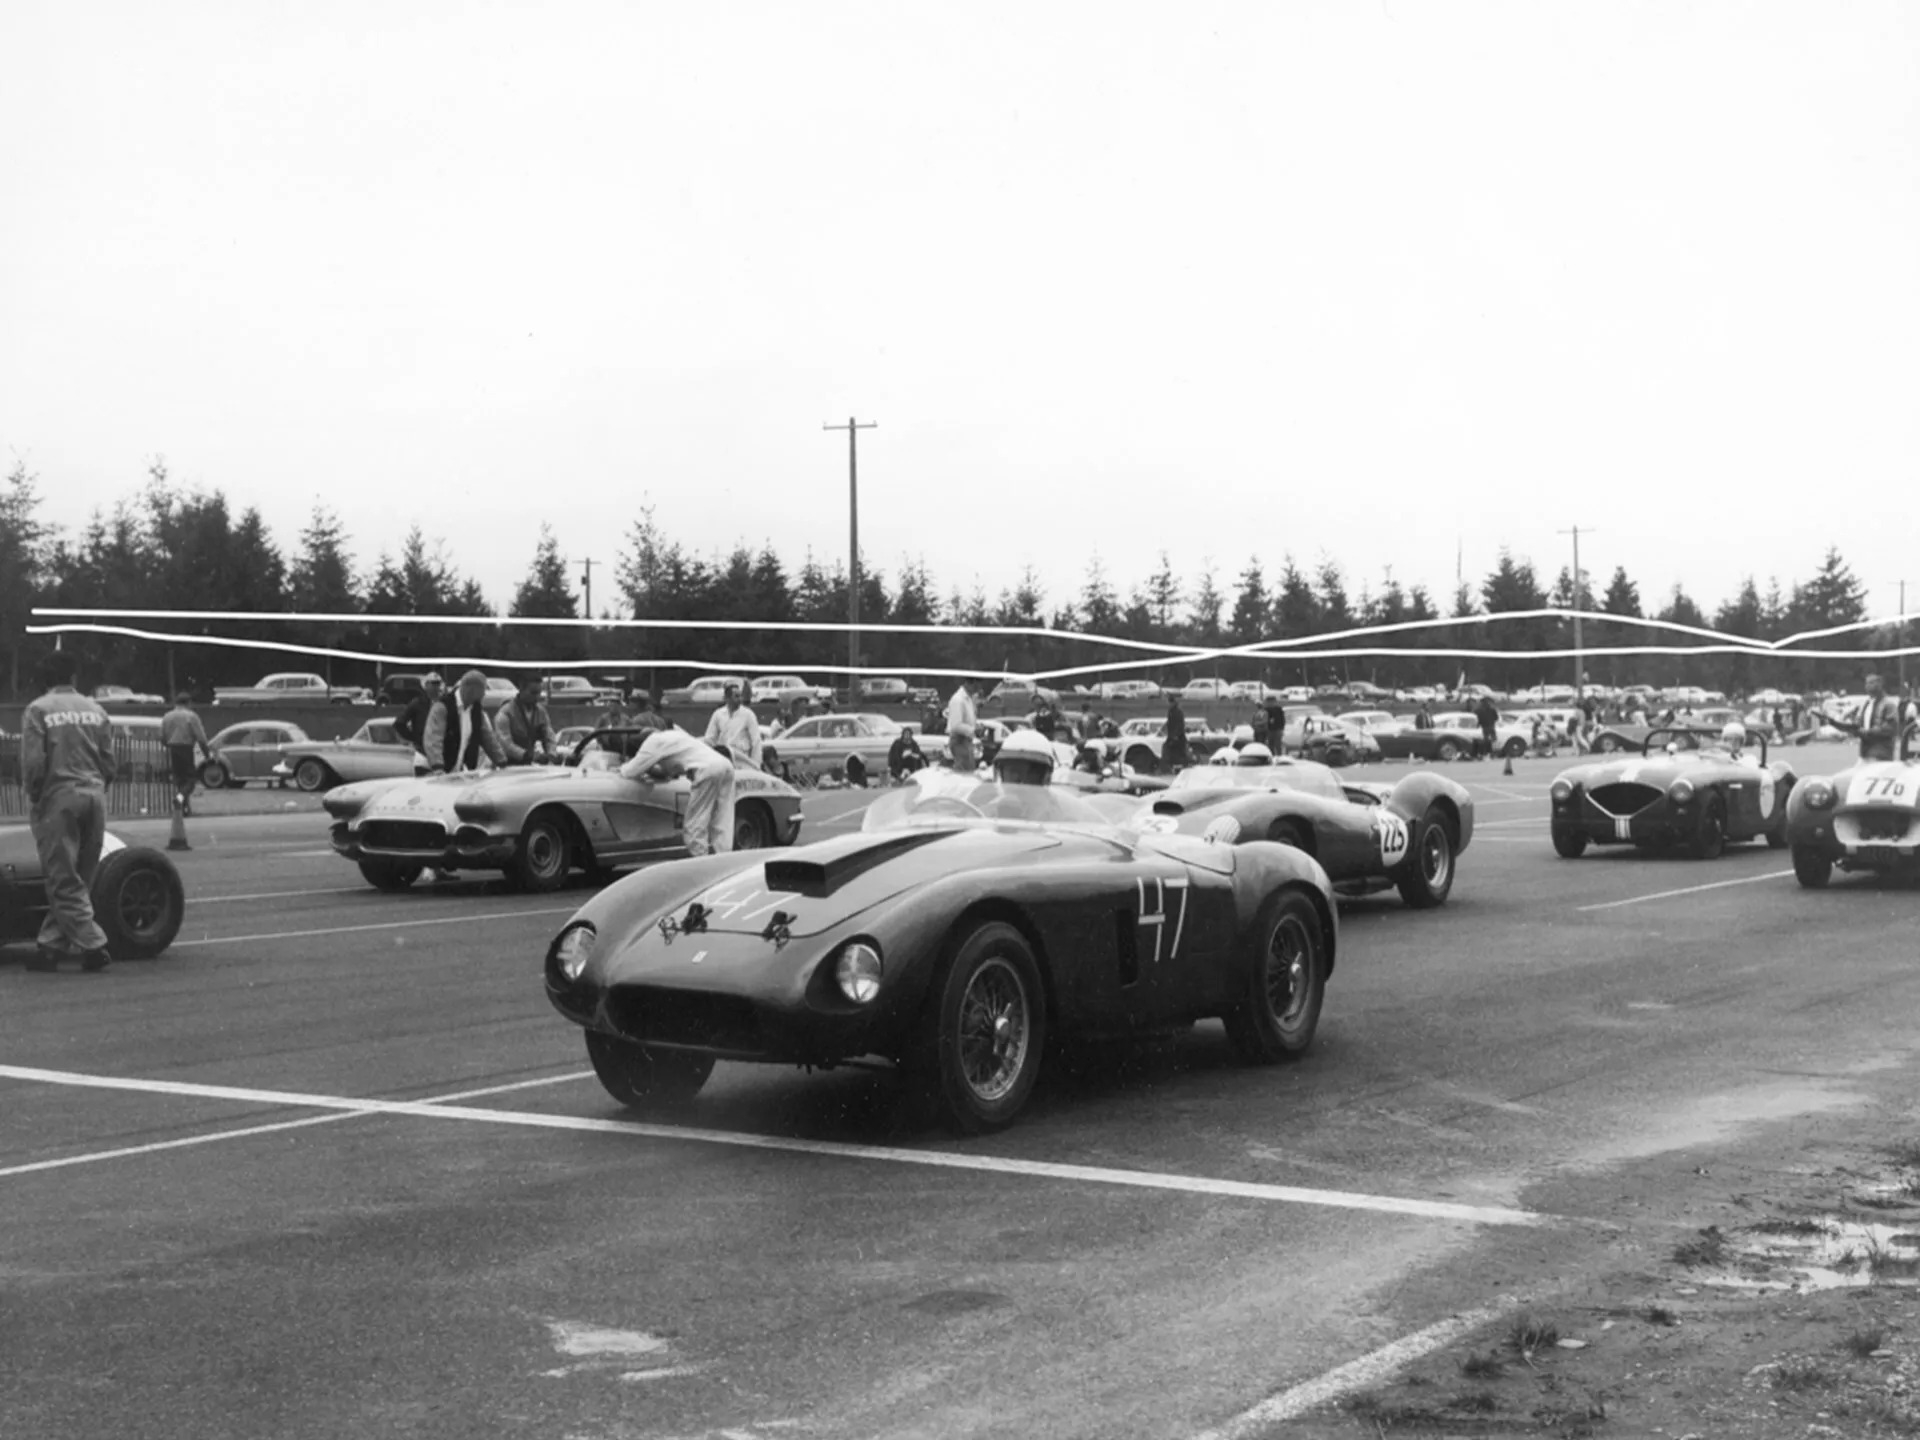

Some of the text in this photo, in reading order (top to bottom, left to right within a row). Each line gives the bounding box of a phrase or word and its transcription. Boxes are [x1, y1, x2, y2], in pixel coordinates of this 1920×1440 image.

[1379, 818, 1406, 854] 225
[707, 888, 803, 920] 47
[1136, 876, 1189, 962] 47
